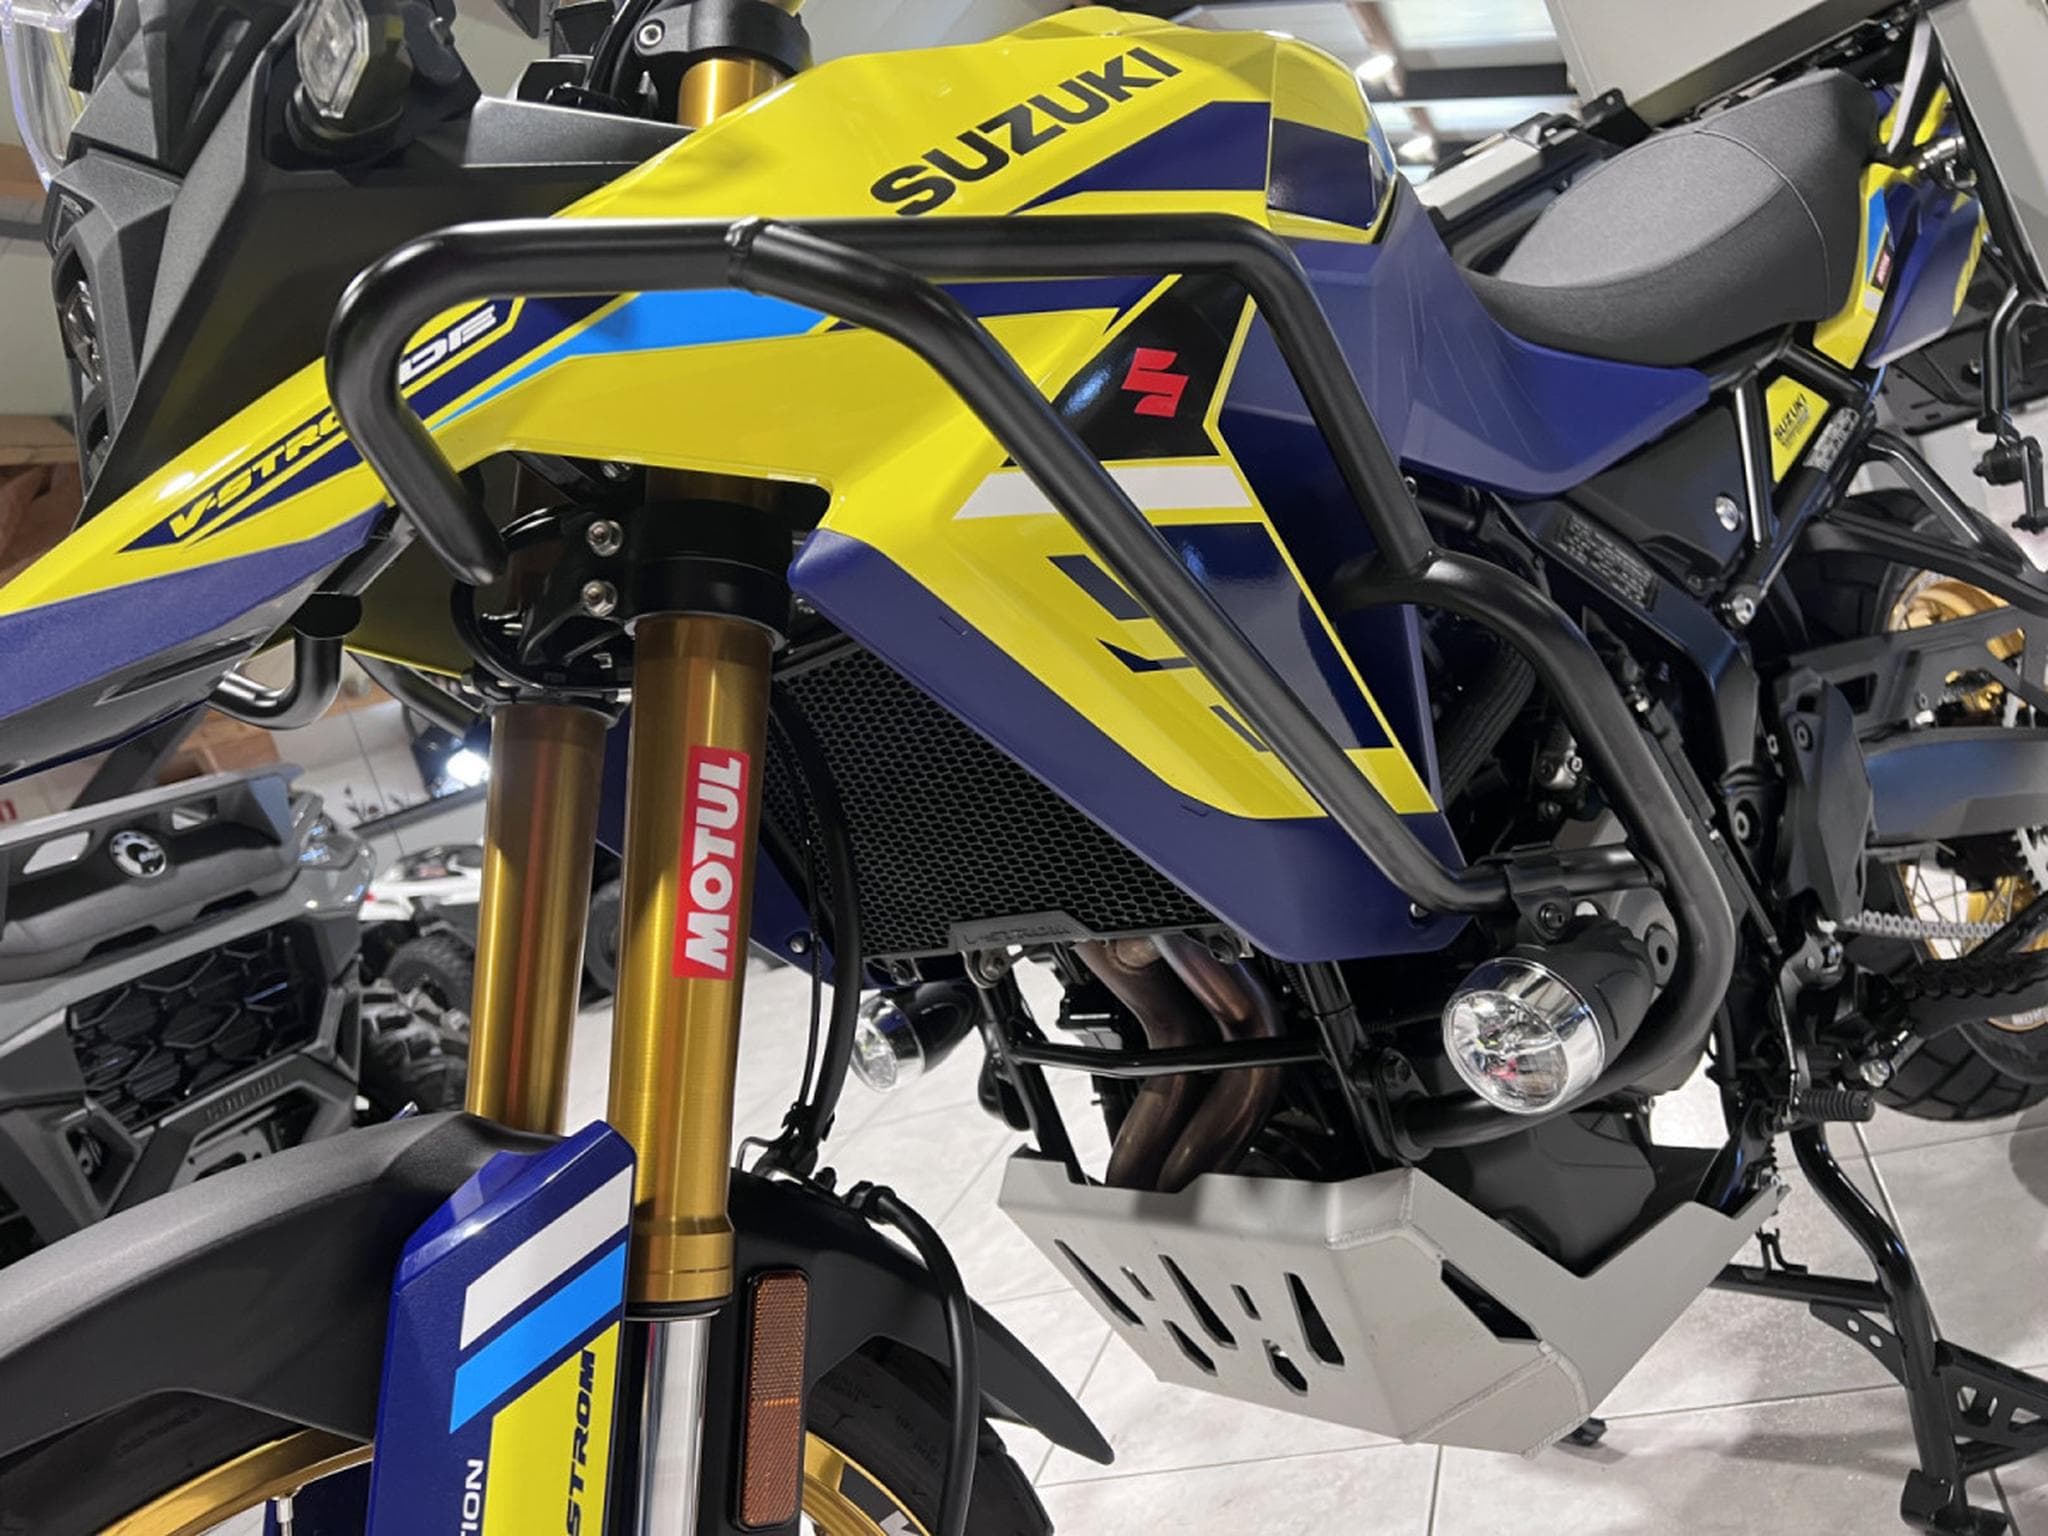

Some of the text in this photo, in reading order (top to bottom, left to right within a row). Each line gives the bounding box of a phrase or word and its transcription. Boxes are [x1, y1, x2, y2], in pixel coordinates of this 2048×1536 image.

[870, 47, 1183, 217] SUZUKI
[685, 757, 742, 973] MOTUL
[460, 1459, 483, 1536] ION
